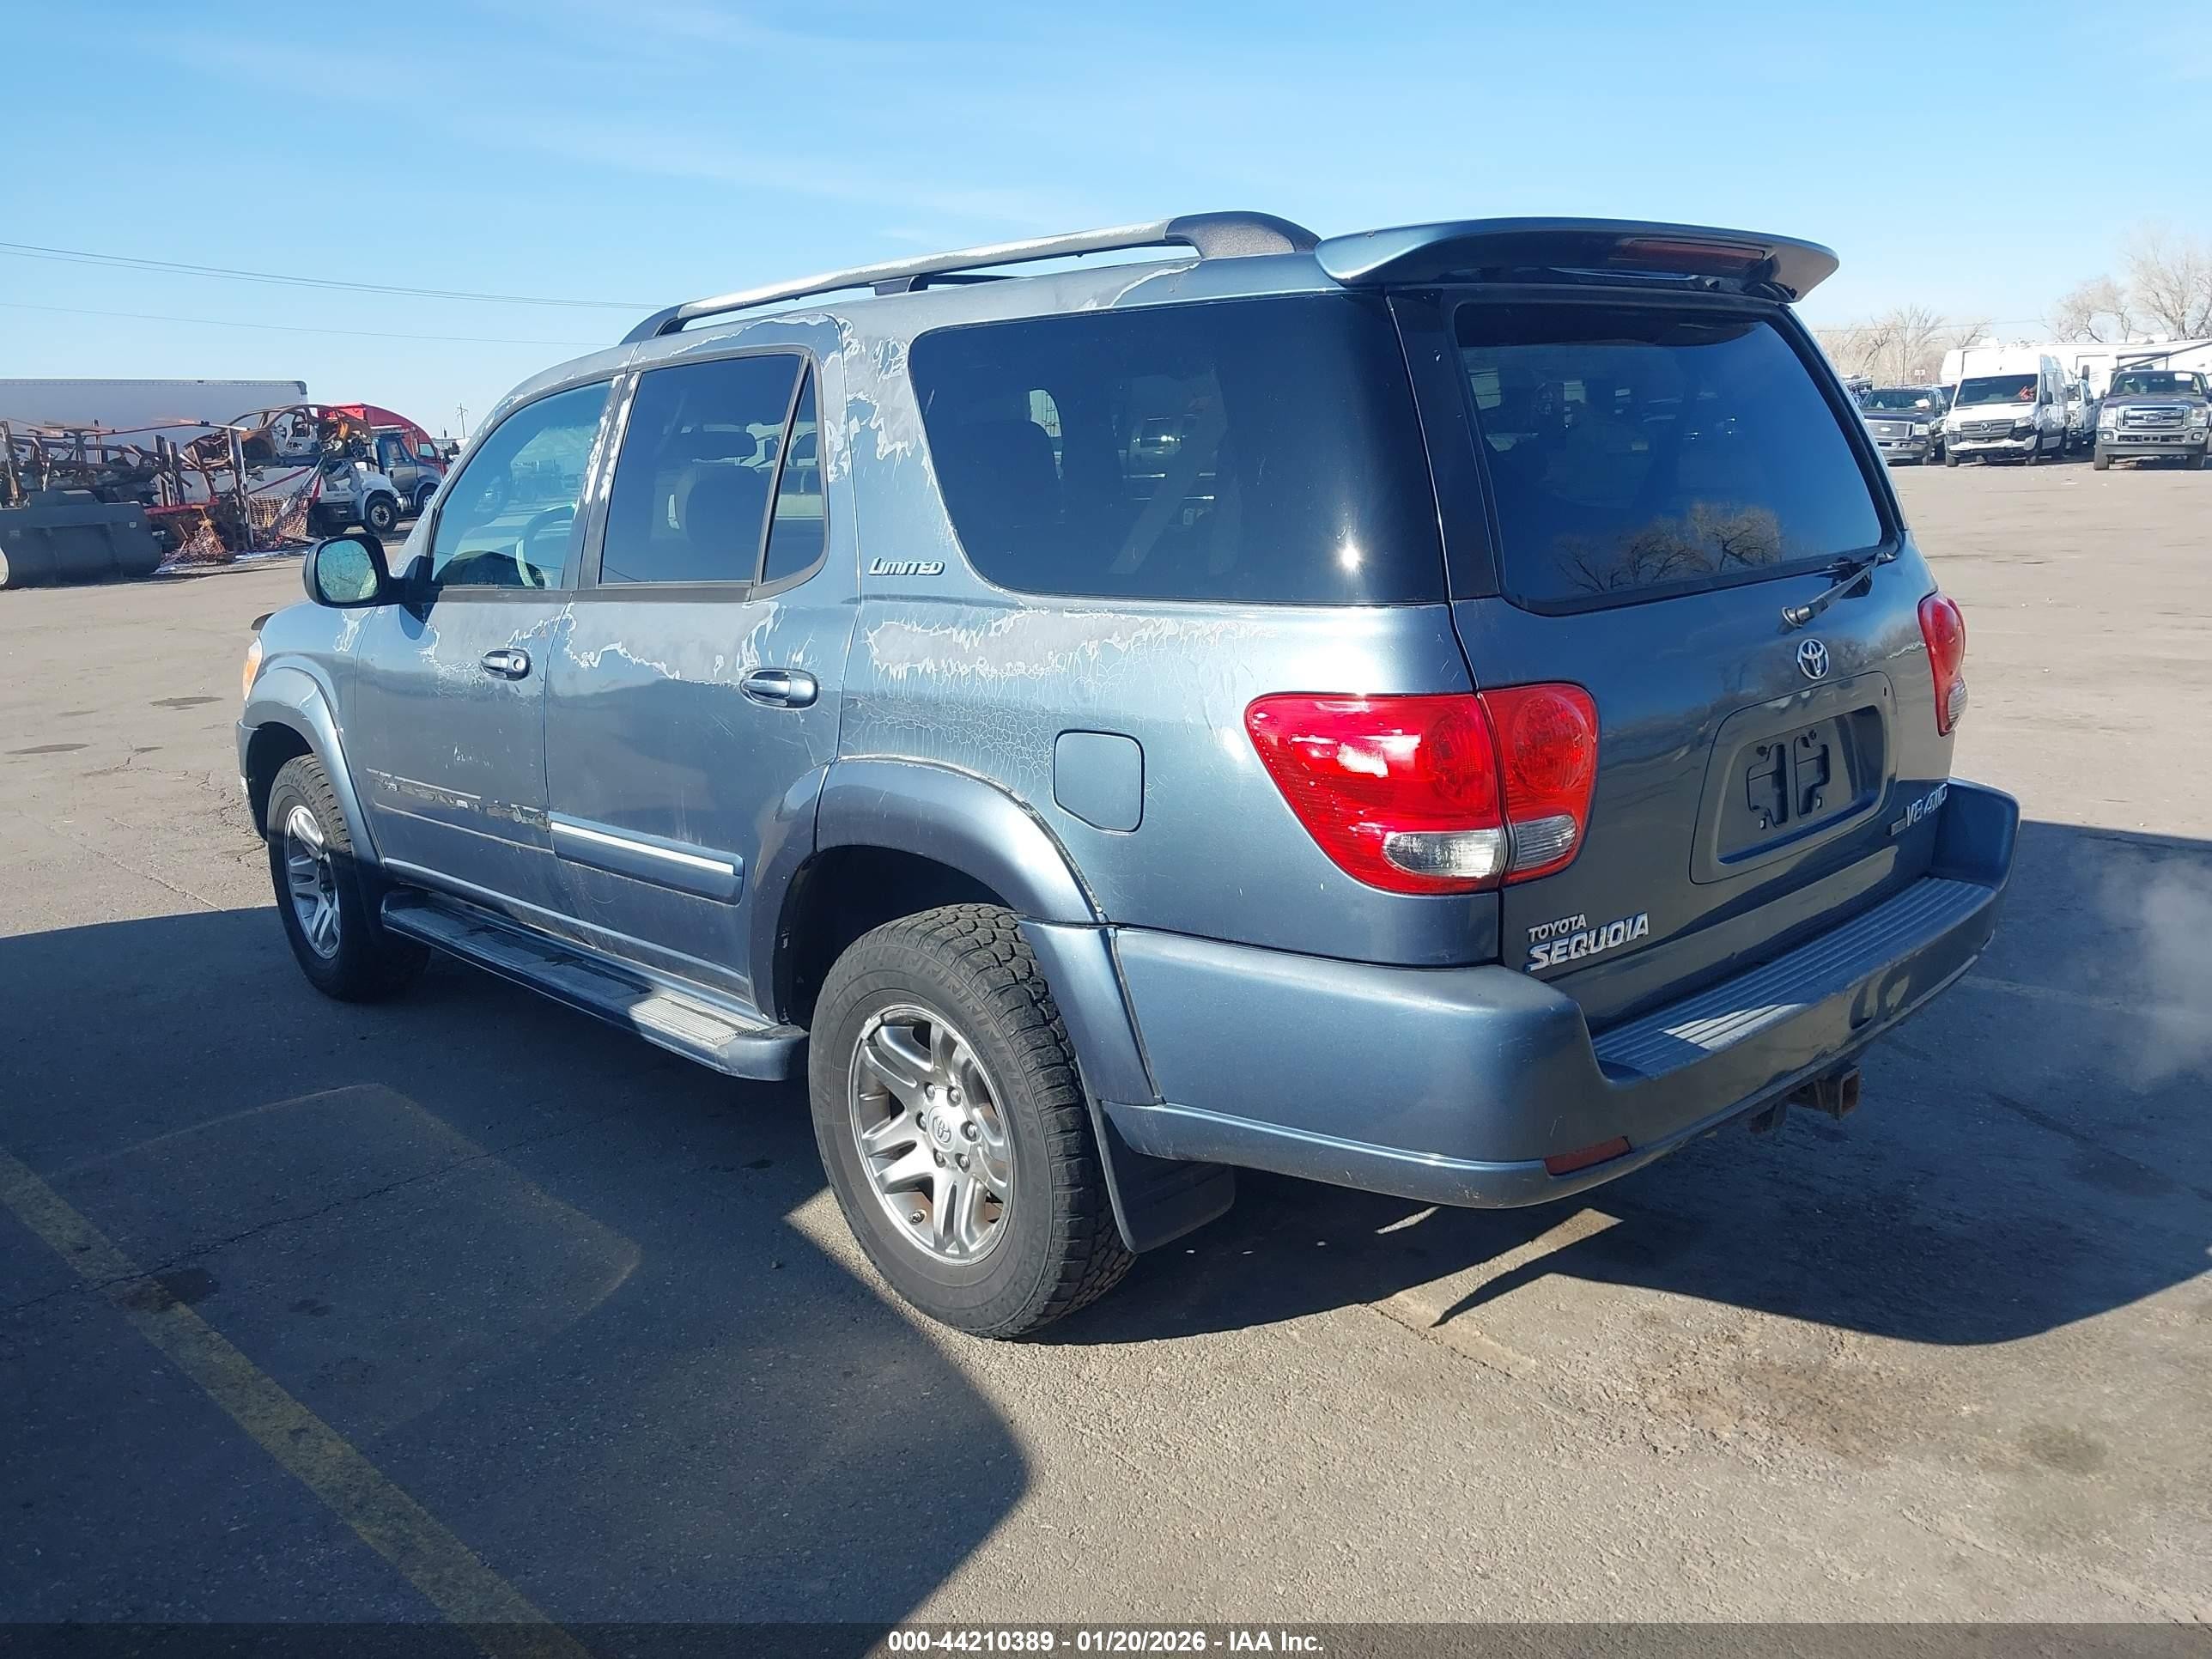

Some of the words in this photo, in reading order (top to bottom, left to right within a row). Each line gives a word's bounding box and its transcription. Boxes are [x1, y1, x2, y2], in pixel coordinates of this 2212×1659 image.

[868, 556, 945, 576] LIMITED
[1528, 913, 1588, 942] TOYOTA
[1526, 913, 1650, 972] SEQUOIA
